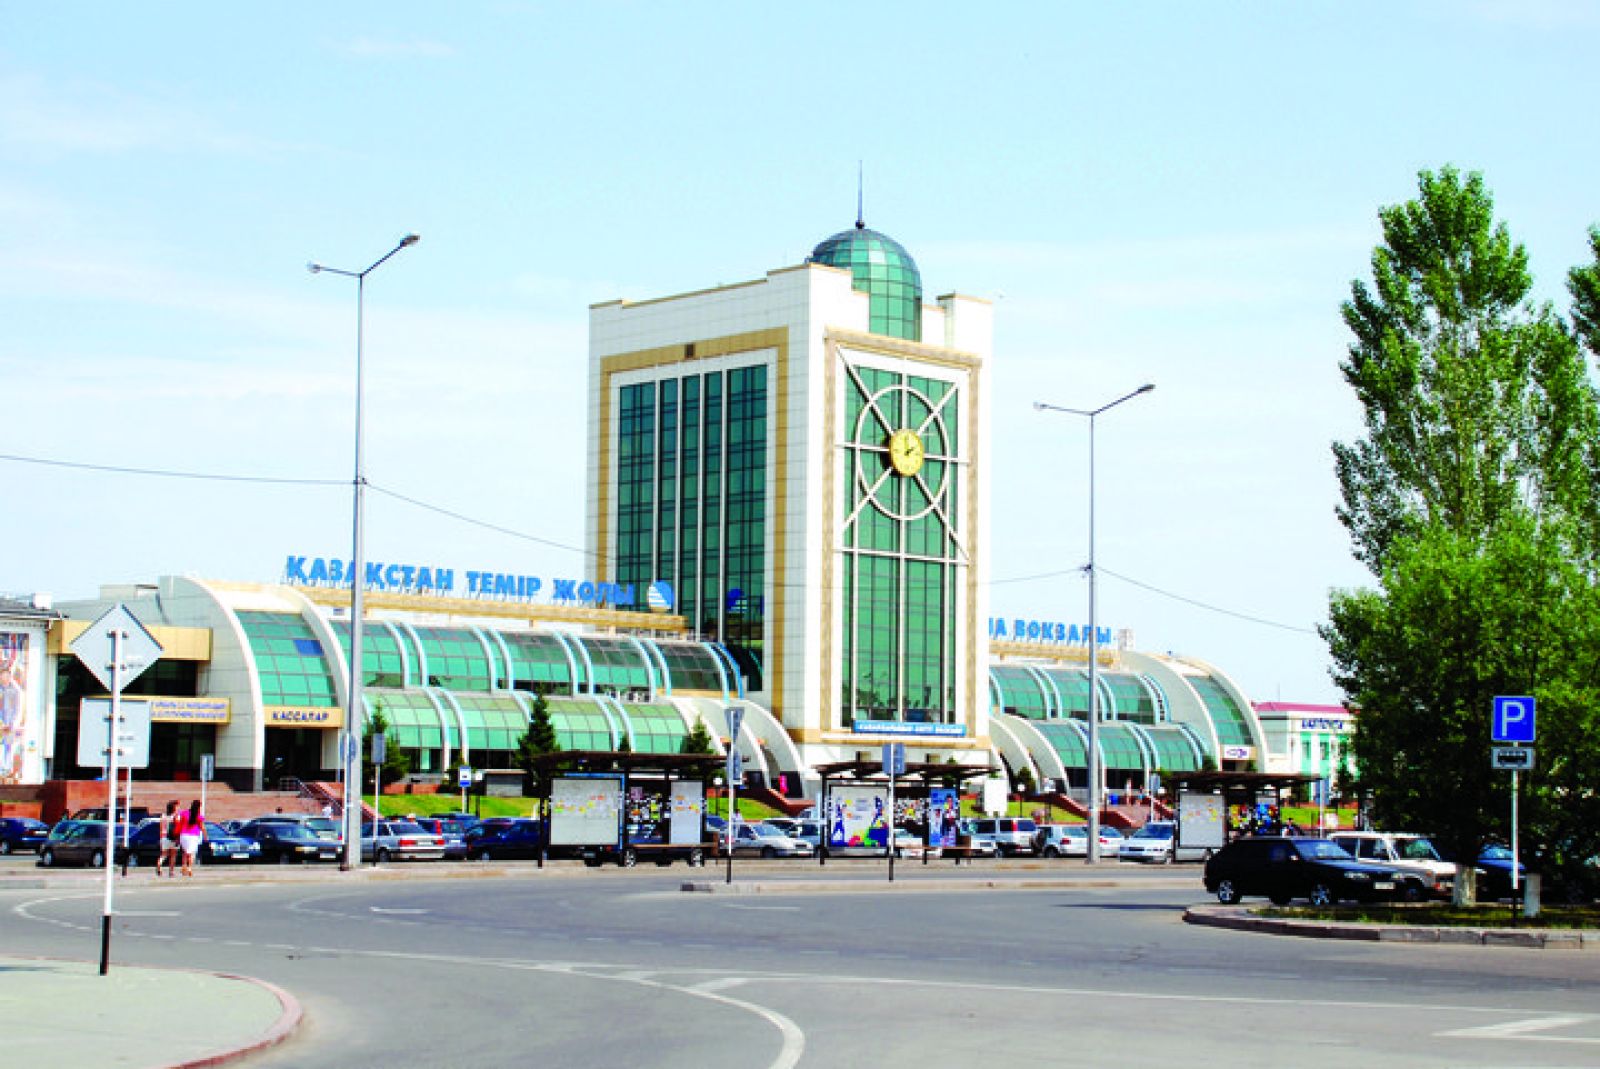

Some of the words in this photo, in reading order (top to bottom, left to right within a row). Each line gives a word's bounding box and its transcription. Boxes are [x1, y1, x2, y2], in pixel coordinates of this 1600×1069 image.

[466, 571, 541, 597] ТЕМІР
[553, 579, 635, 605] ЖОЛЫ
[1502, 701, 1525, 737] P
